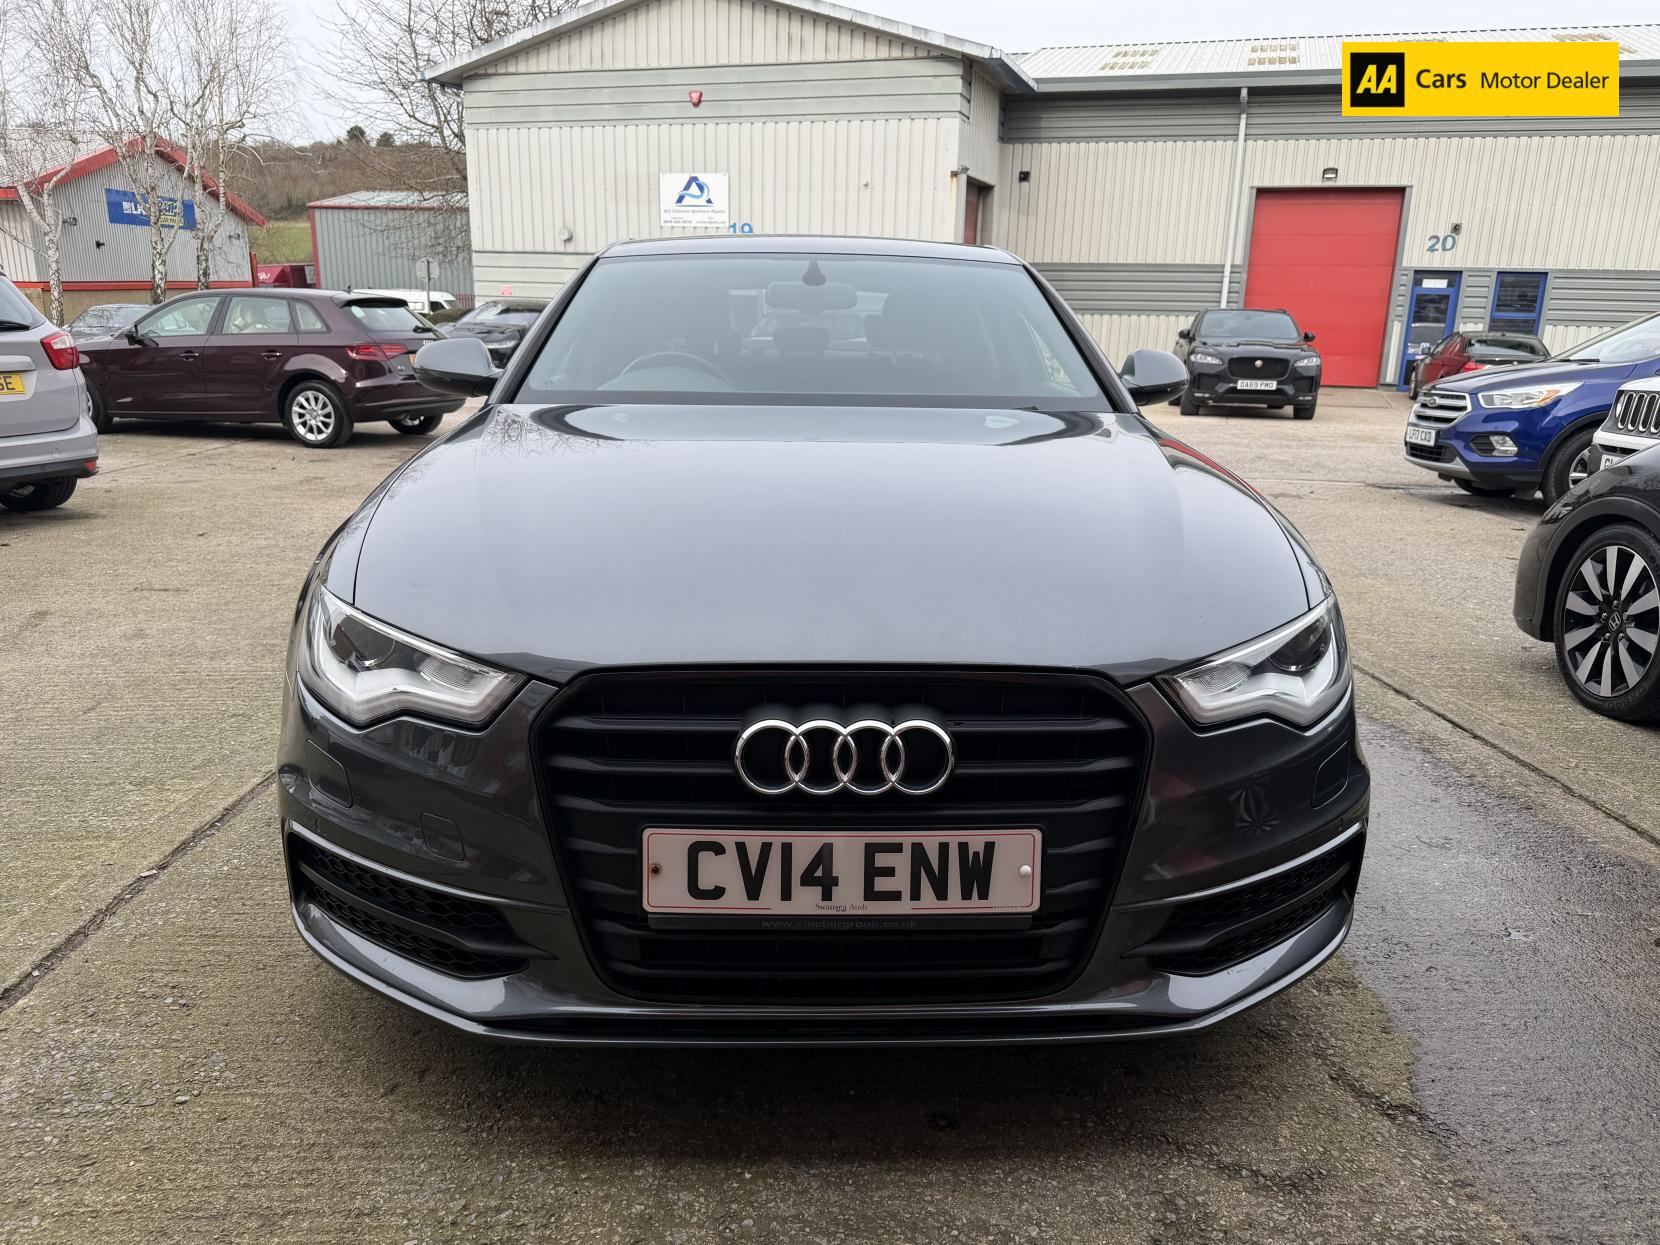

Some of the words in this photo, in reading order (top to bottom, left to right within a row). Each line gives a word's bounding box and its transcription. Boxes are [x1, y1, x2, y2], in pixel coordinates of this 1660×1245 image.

[731, 222, 754, 234] 19
[1427, 235, 1457, 252] 20
[687, 840, 840, 902] CV14
[863, 841, 996, 902] ENW
[815, 903, 847, 912] Swansea
[848, 903, 869, 912] Audi
